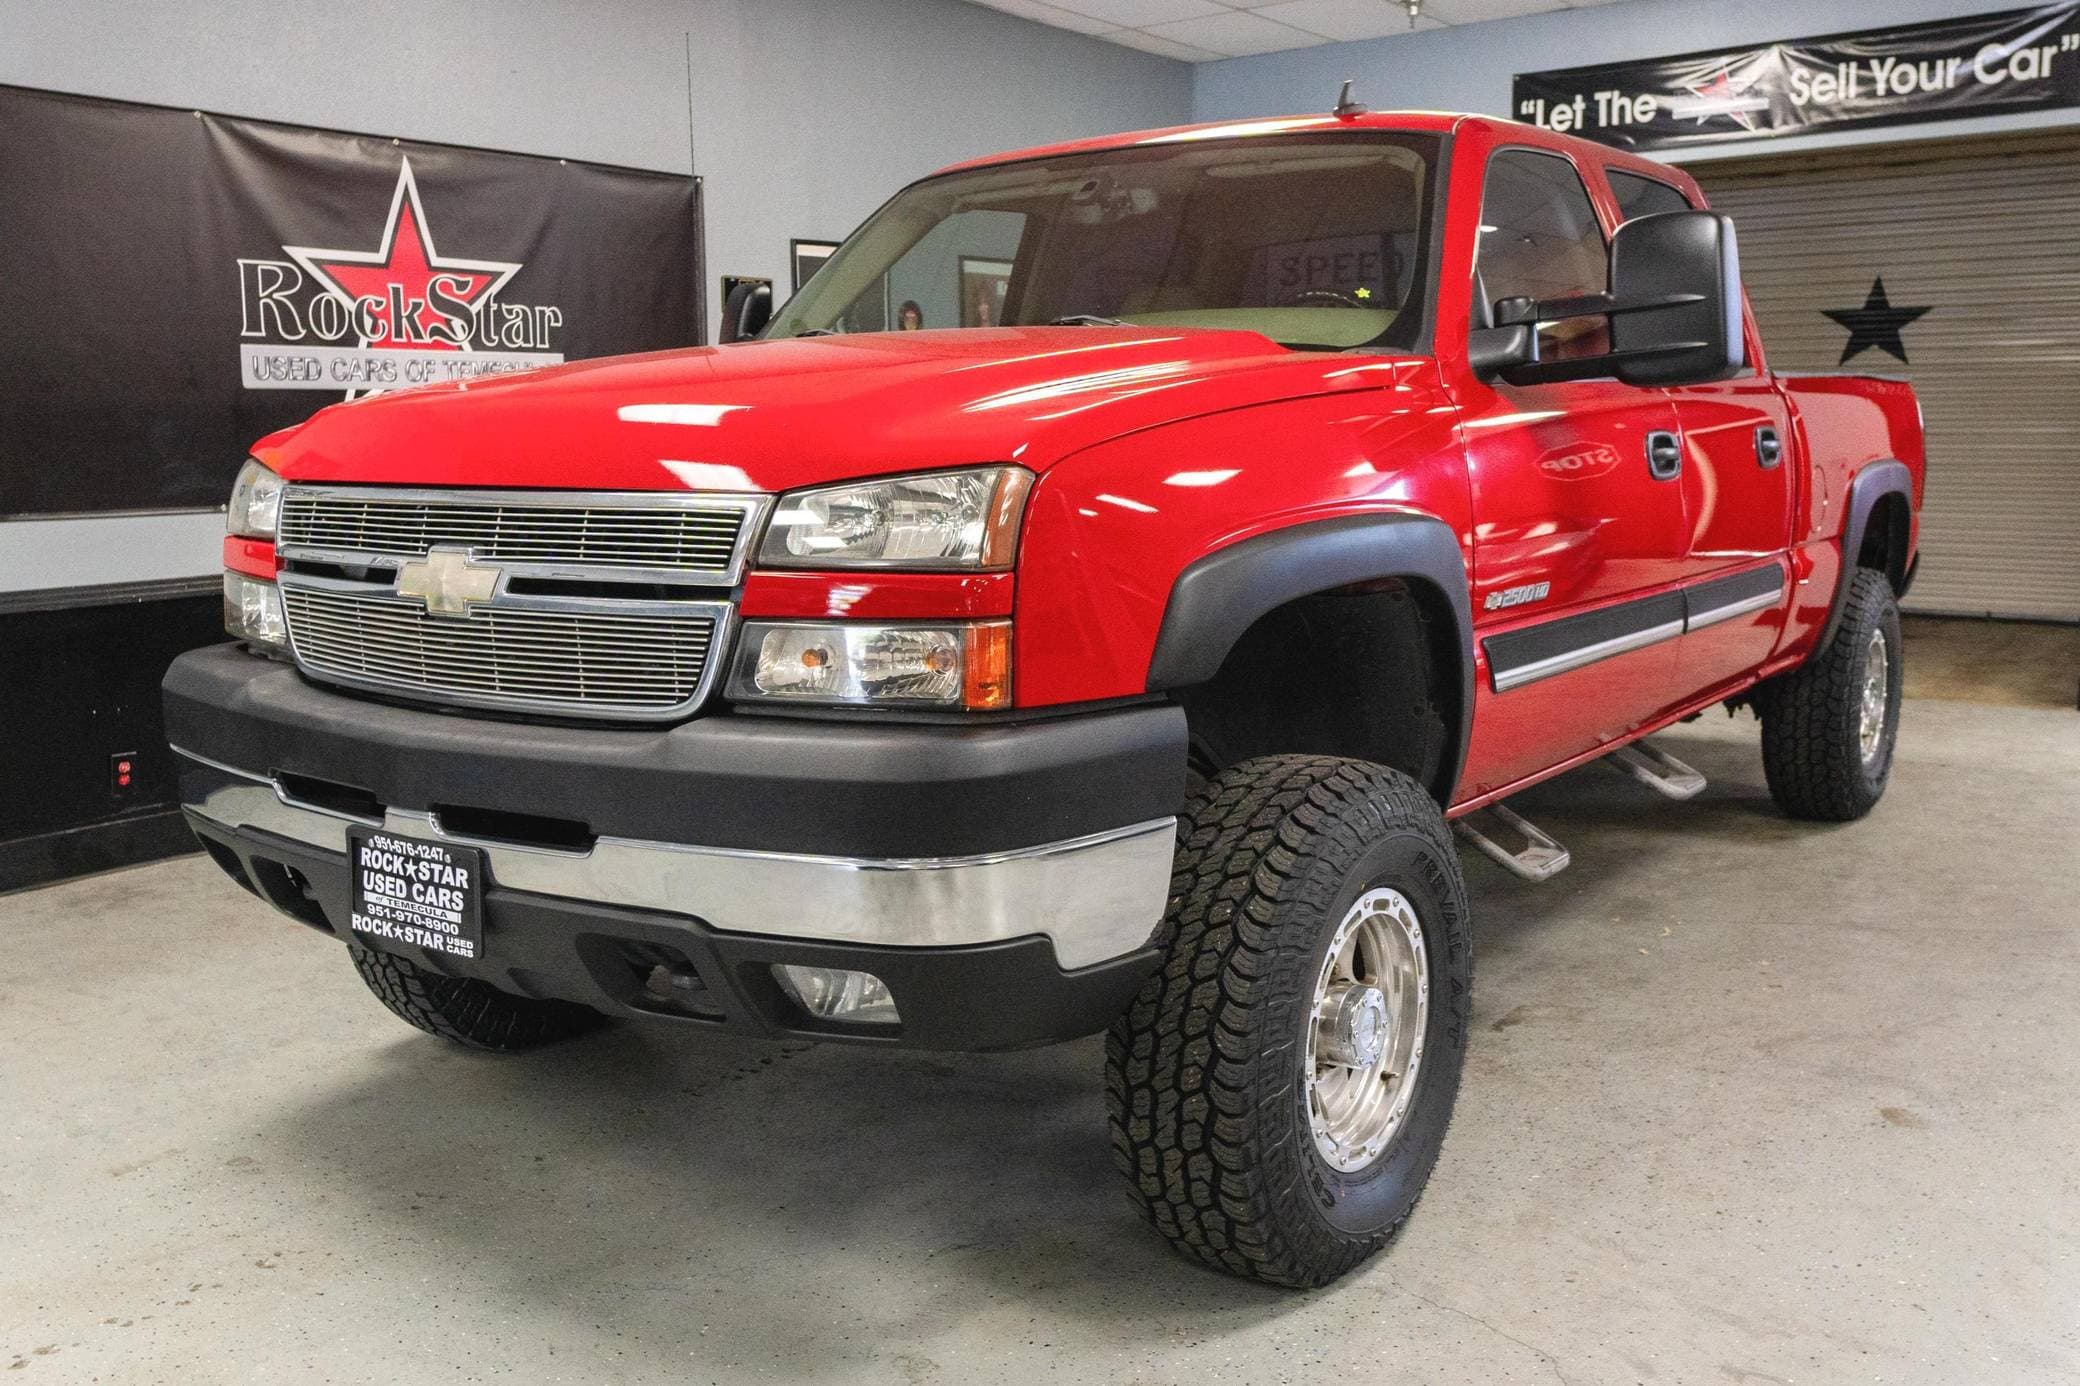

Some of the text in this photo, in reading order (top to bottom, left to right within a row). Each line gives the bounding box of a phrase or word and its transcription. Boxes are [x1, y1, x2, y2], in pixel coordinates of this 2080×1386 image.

[1593, 89, 1658, 128] The
[1788, 61, 1858, 107] Sell
[1869, 56, 1962, 97] Your
[237, 258, 562, 349] RockStar
[252, 355, 322, 382] USED
[330, 356, 397, 383] CARS
[404, 358, 436, 383] OF
[373, 834, 444, 862] 951-676-1247
[363, 869, 464, 912] USED CARS
[367, 903, 459, 936] 951-970-8900
[387, 898, 448, 919] TEMECULA
[446, 935, 474, 949] USED
[446, 945, 474, 959] CARS
